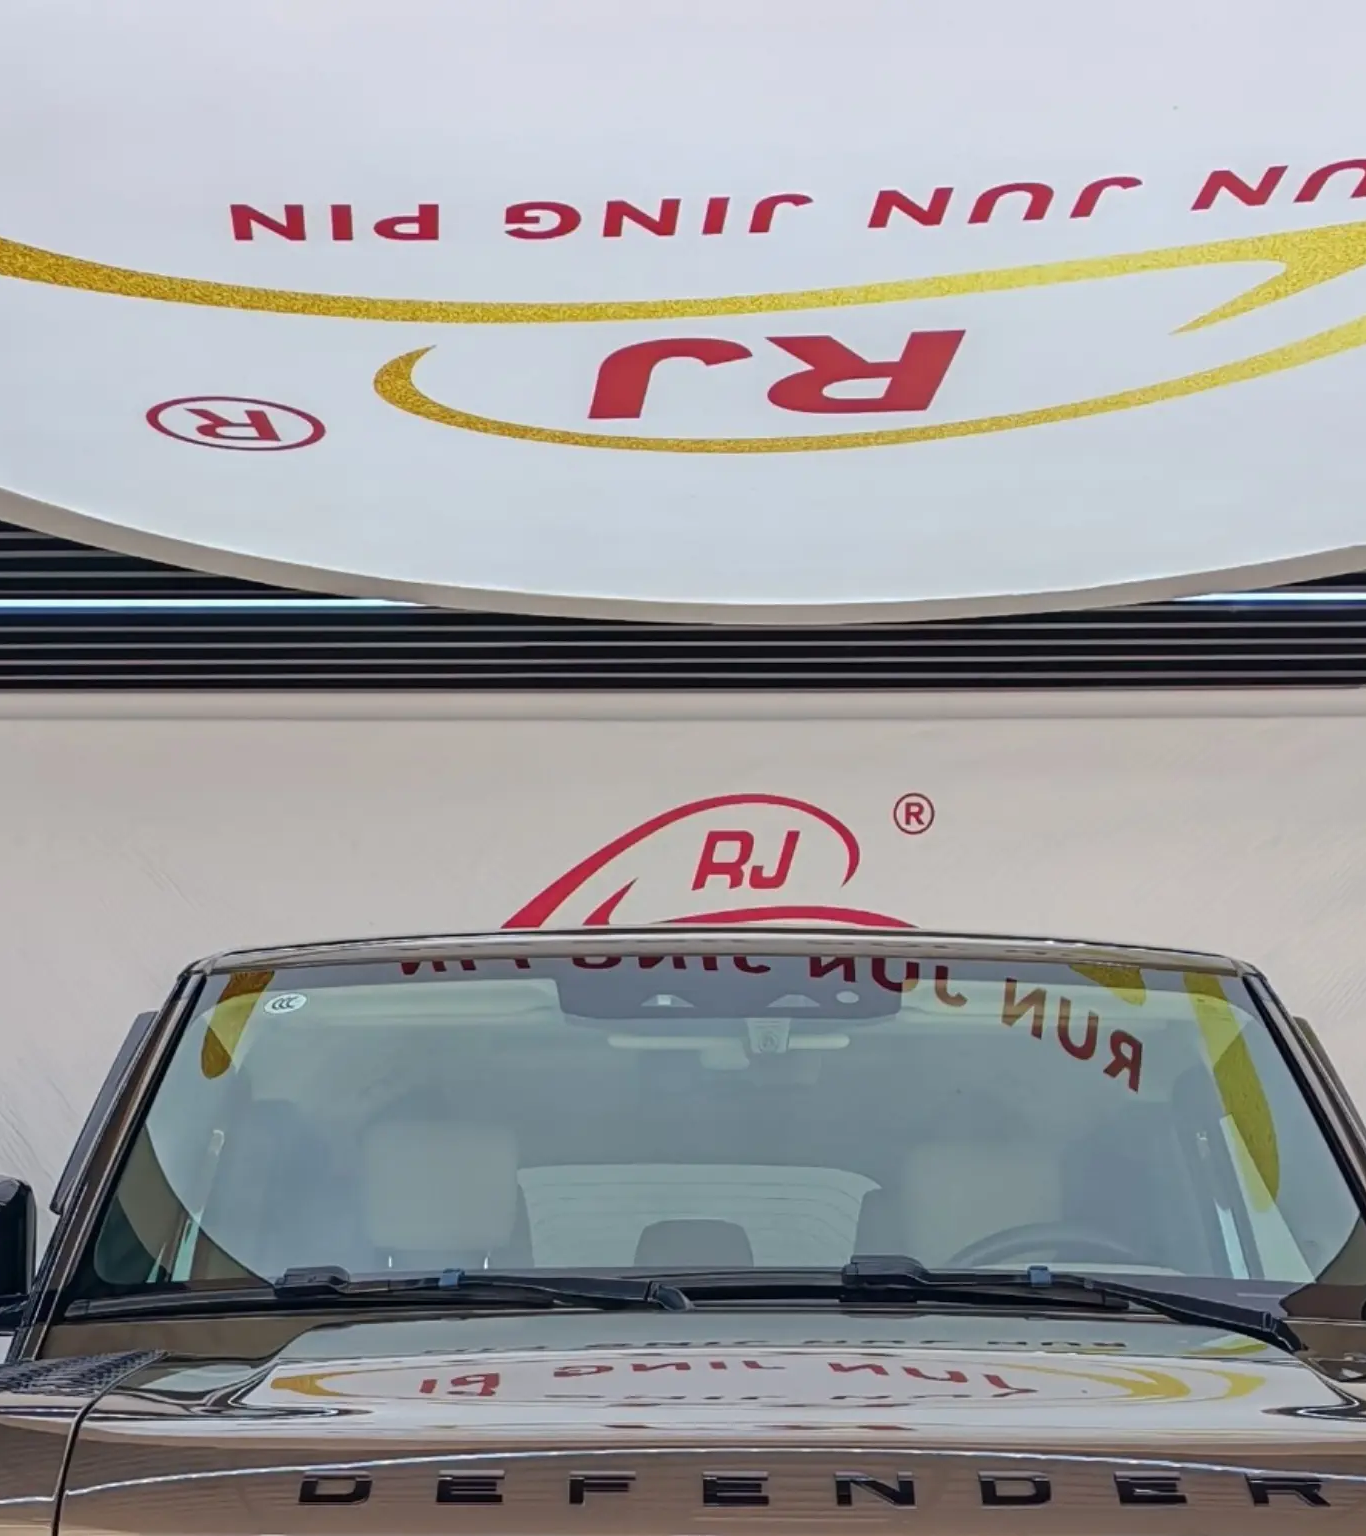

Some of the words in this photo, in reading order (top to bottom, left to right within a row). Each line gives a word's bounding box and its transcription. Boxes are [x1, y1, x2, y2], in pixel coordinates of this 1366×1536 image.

[230, 203, 439, 242] PIN
[504, 193, 812, 241] JING
[867, 177, 1143, 229] JUN
[588, 329, 965, 421] RJ
[691, 829, 801, 891] RJ
[298, 1469, 1332, 1506] DEFENDER
